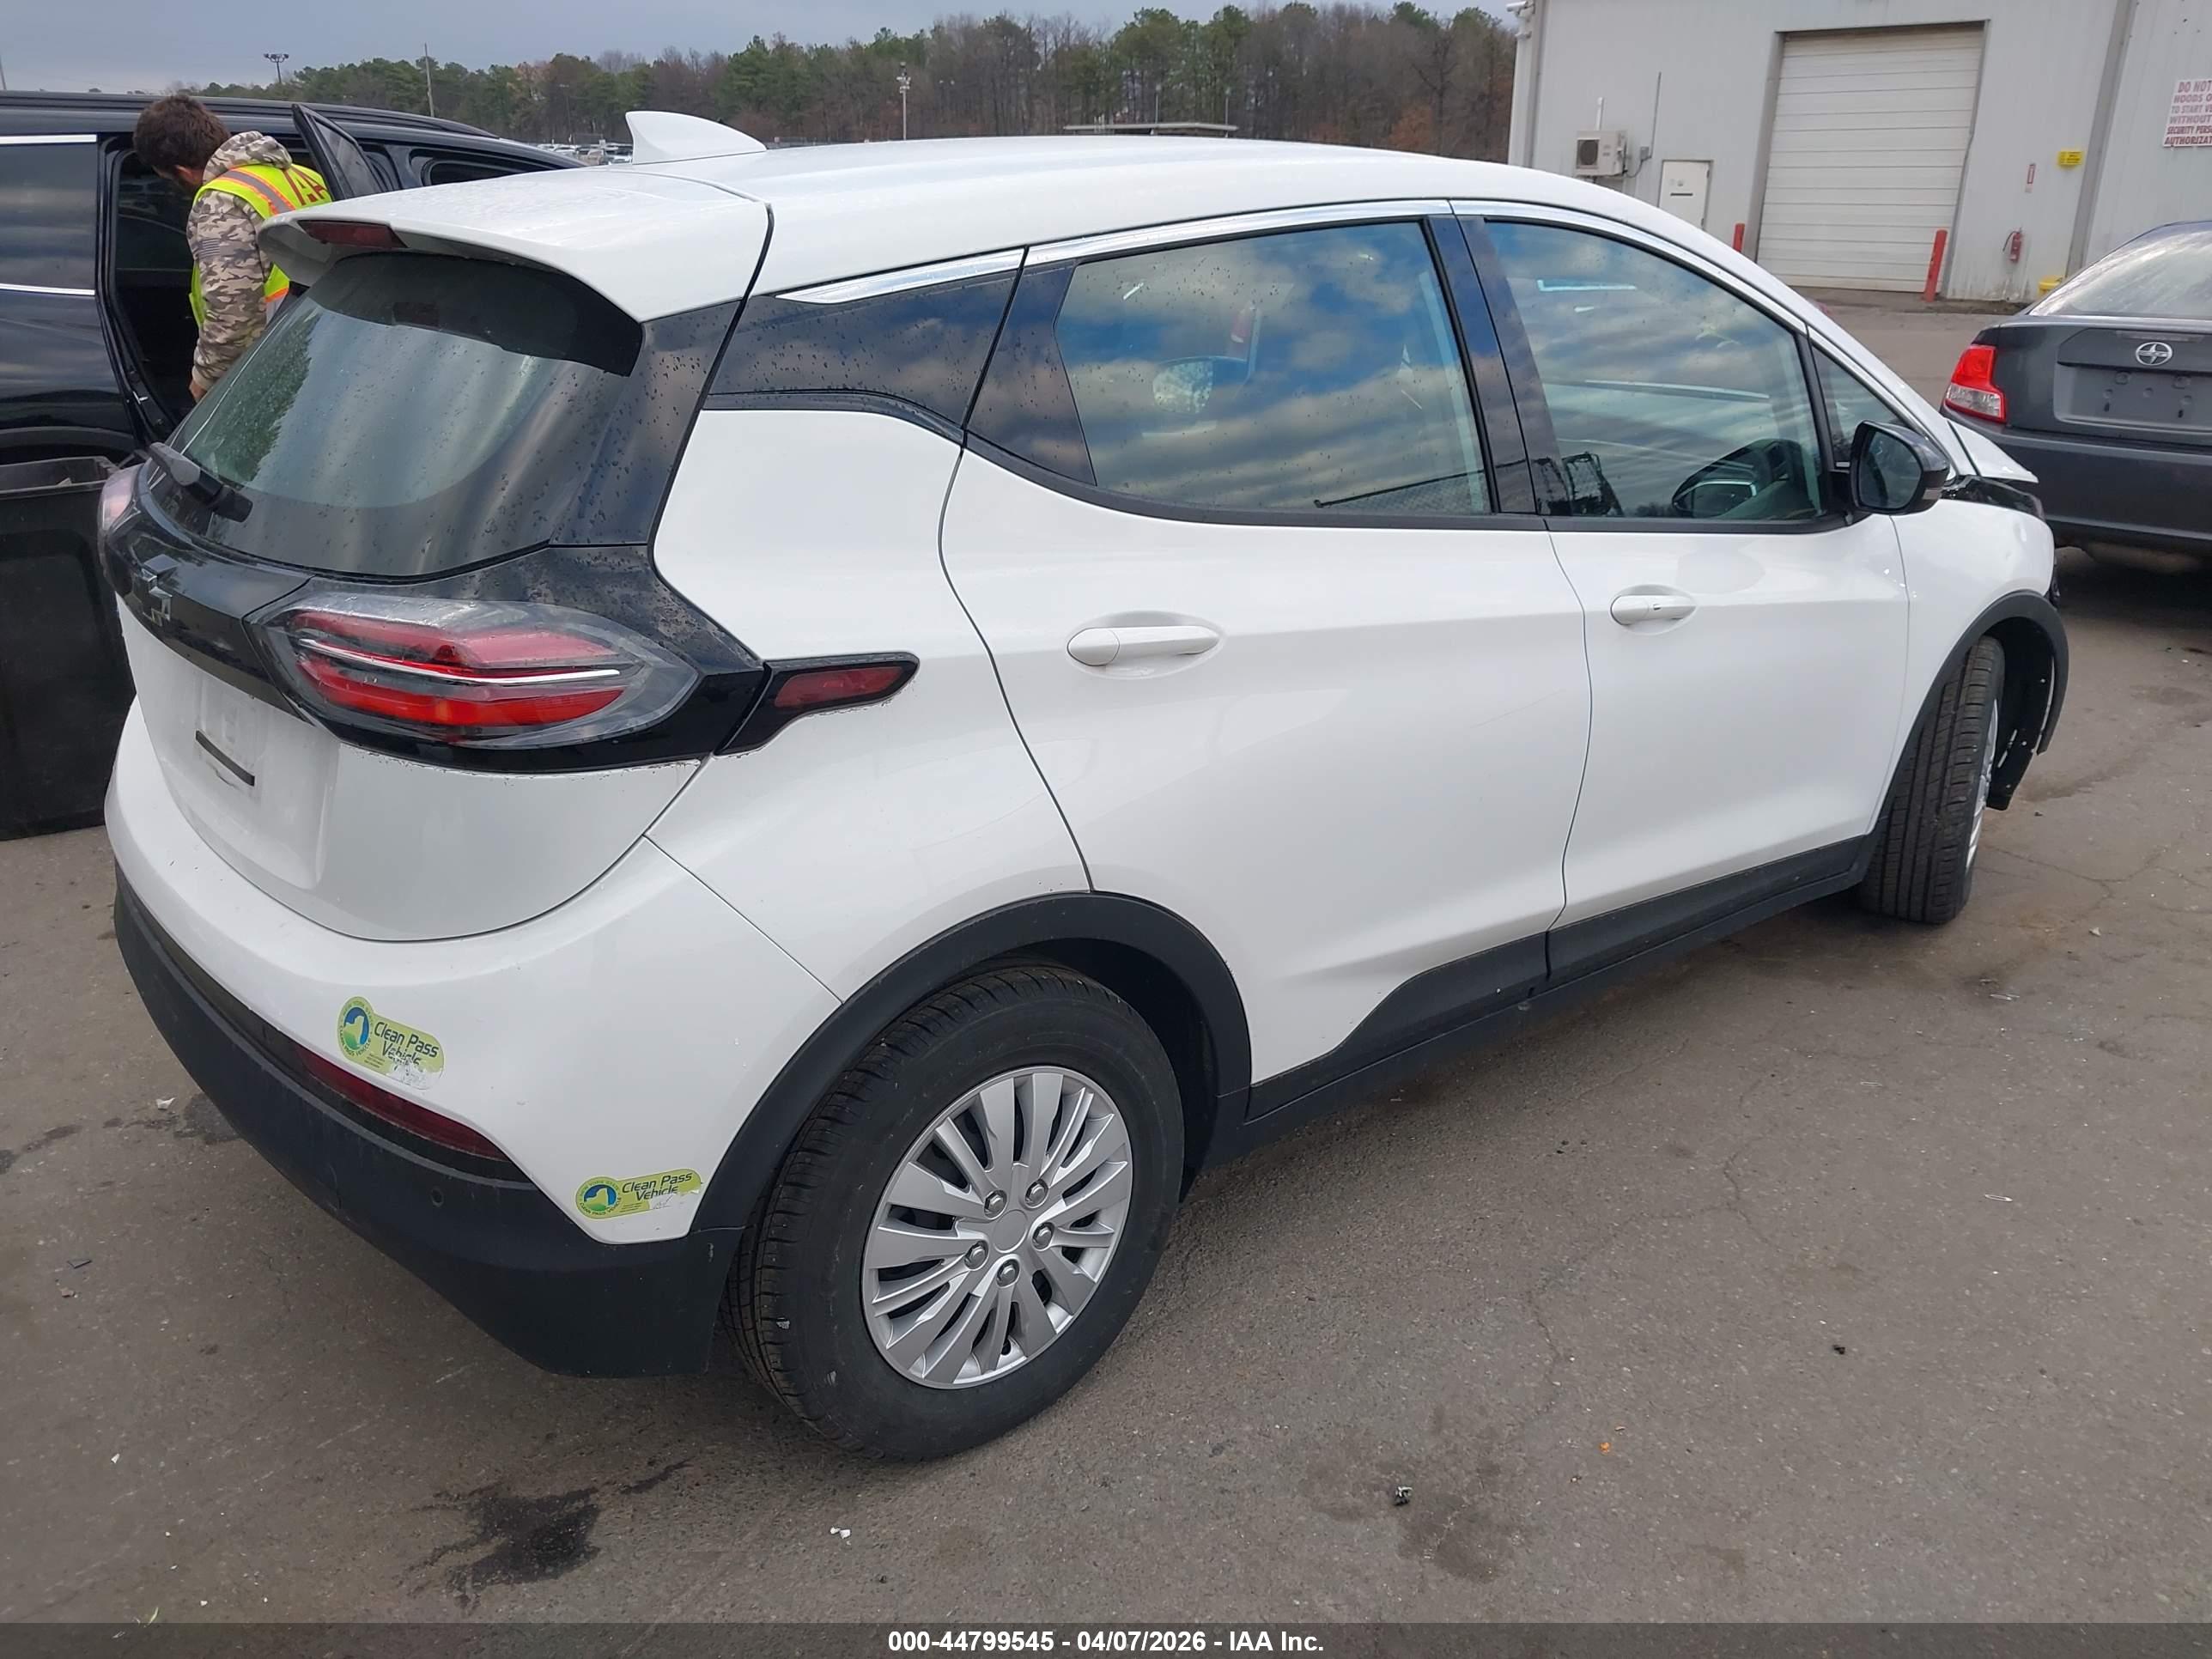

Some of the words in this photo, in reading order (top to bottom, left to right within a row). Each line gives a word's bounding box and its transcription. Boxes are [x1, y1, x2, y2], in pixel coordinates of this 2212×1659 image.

[2178, 82, 2191, 94] DO
[2193, 80, 2212, 92] NOT
[2173, 94, 2203, 104] HOODS
[2170, 115, 2212, 125] WITHOUT
[2166, 126, 2195, 135] SECURITY
[374, 1021, 405, 1046] Clean
[406, 1033, 440, 1059] Pass
[622, 1180, 656, 1194] Clean
[660, 1172, 693, 1187] Pass
[635, 1184, 678, 1201] Vehicle
